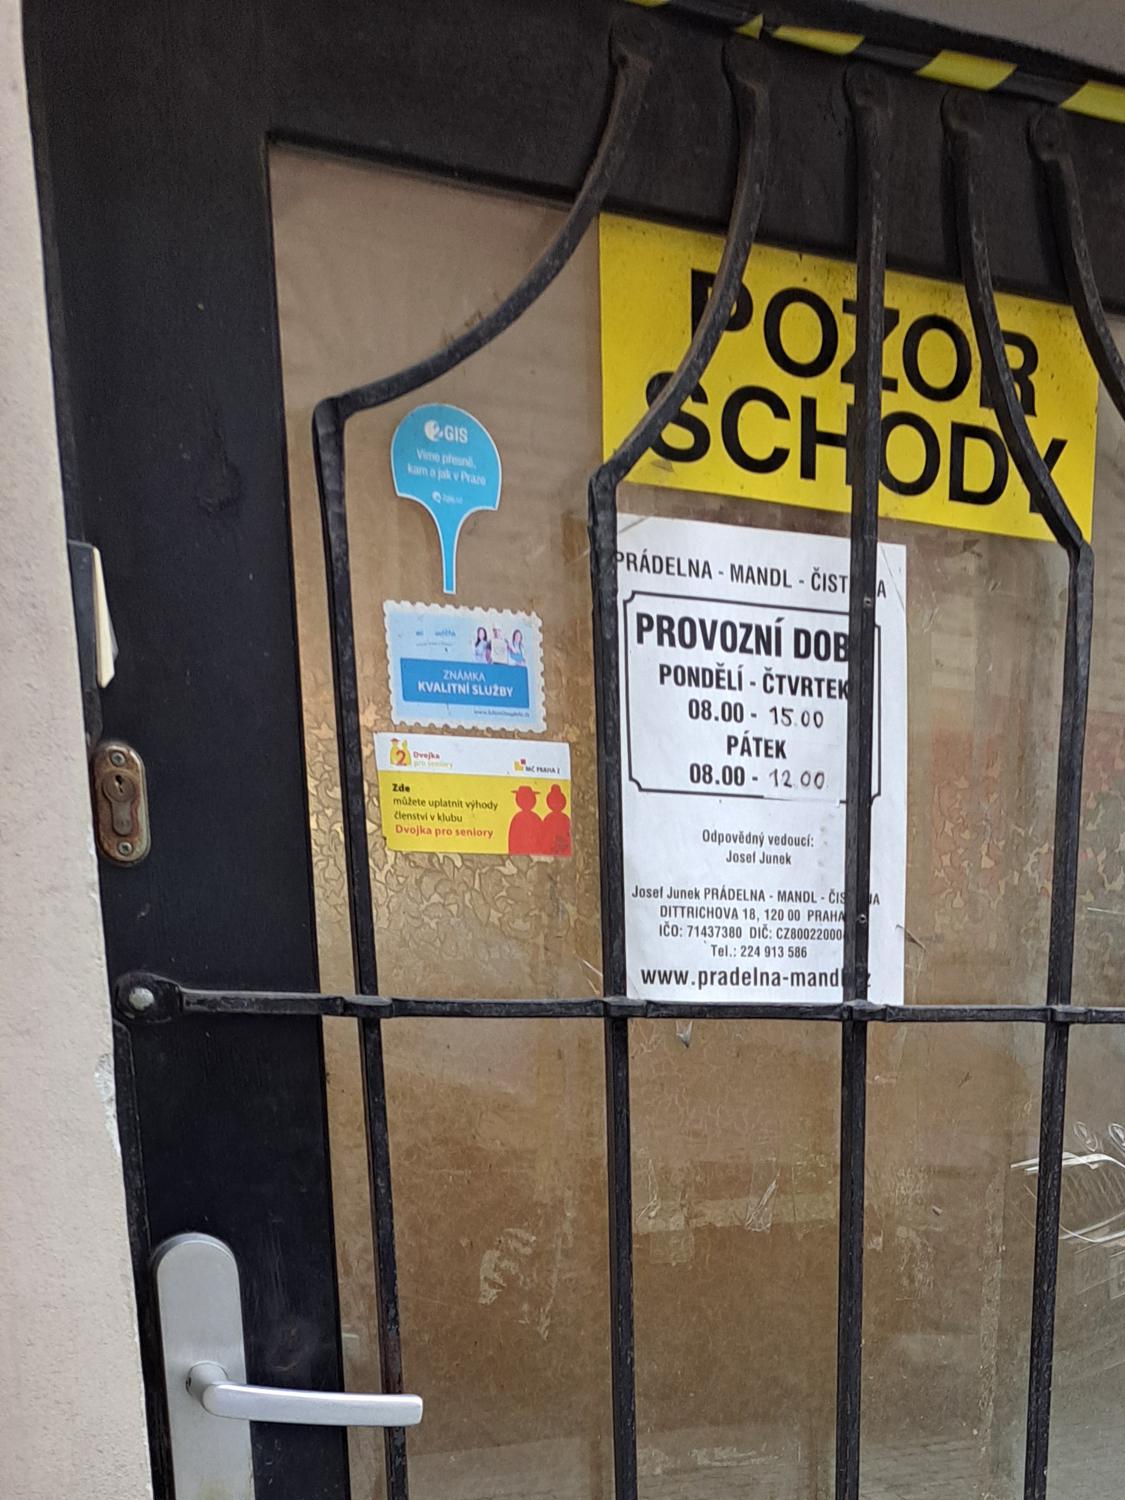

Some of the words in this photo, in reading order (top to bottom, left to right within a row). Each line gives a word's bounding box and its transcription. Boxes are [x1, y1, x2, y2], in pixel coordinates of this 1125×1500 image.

[690, 269, 1039, 416] POZOR
[615, 548, 713, 580] PRÁDELNA
[730, 563, 792, 588] MANDL
[811, 566, 887, 599] ČISTA
[635, 611, 785, 658] PROVOZNÍ
[793, 627, 849, 663] DOB
[443, 669, 486, 682] ZNÁMKA
[658, 662, 744, 692] PONDĚLÍ
[762, 665, 849, 701] ČTVRTEK
[418, 681, 470, 695] KVALITNÍ
[472, 685, 514, 698] SLUŽBY
[688, 698, 745, 724] 08.00
[726, 730, 787, 760] PÁTEK
[689, 763, 745, 787] 08.00
[392, 784, 410, 792] Zde
[393, 795, 426, 806] můžete
[428, 798, 463, 811] uplatnit
[465, 799, 498, 812] výhody
[394, 811, 428, 823] členství
[437, 812, 463, 823] klubu
[395, 824, 432, 836] Dvojka
[434, 828, 453, 838] pro
[455, 828, 494, 840] seniory
[702, 829, 764, 848] Odpovědný
[768, 833, 814, 848] vedoucí:
[726, 850, 756, 864] Josef
[759, 851, 792, 865] Junek
[632, 885, 664, 899] Josef
[667, 886, 701, 900] Junek
[704, 884, 766, 902] PRÁDELNA
[777, 890, 818, 904] MANDL
[660, 905, 739, 920] DITTRICHOVA
[742, 908, 760, 923] 18,
[764, 908, 785, 921] 120
[788, 909, 801, 922] 00
[807, 909, 846, 923] PRAHA
[687, 925, 742, 939] 71437380
[749, 924, 773, 940] DIČ:
[776, 927, 844, 941] CZ80022000
[711, 944, 737, 957] Tel.:
[740, 945, 761, 958] 224
[764, 946, 785, 958] 913
[788, 946, 808, 959] 586
